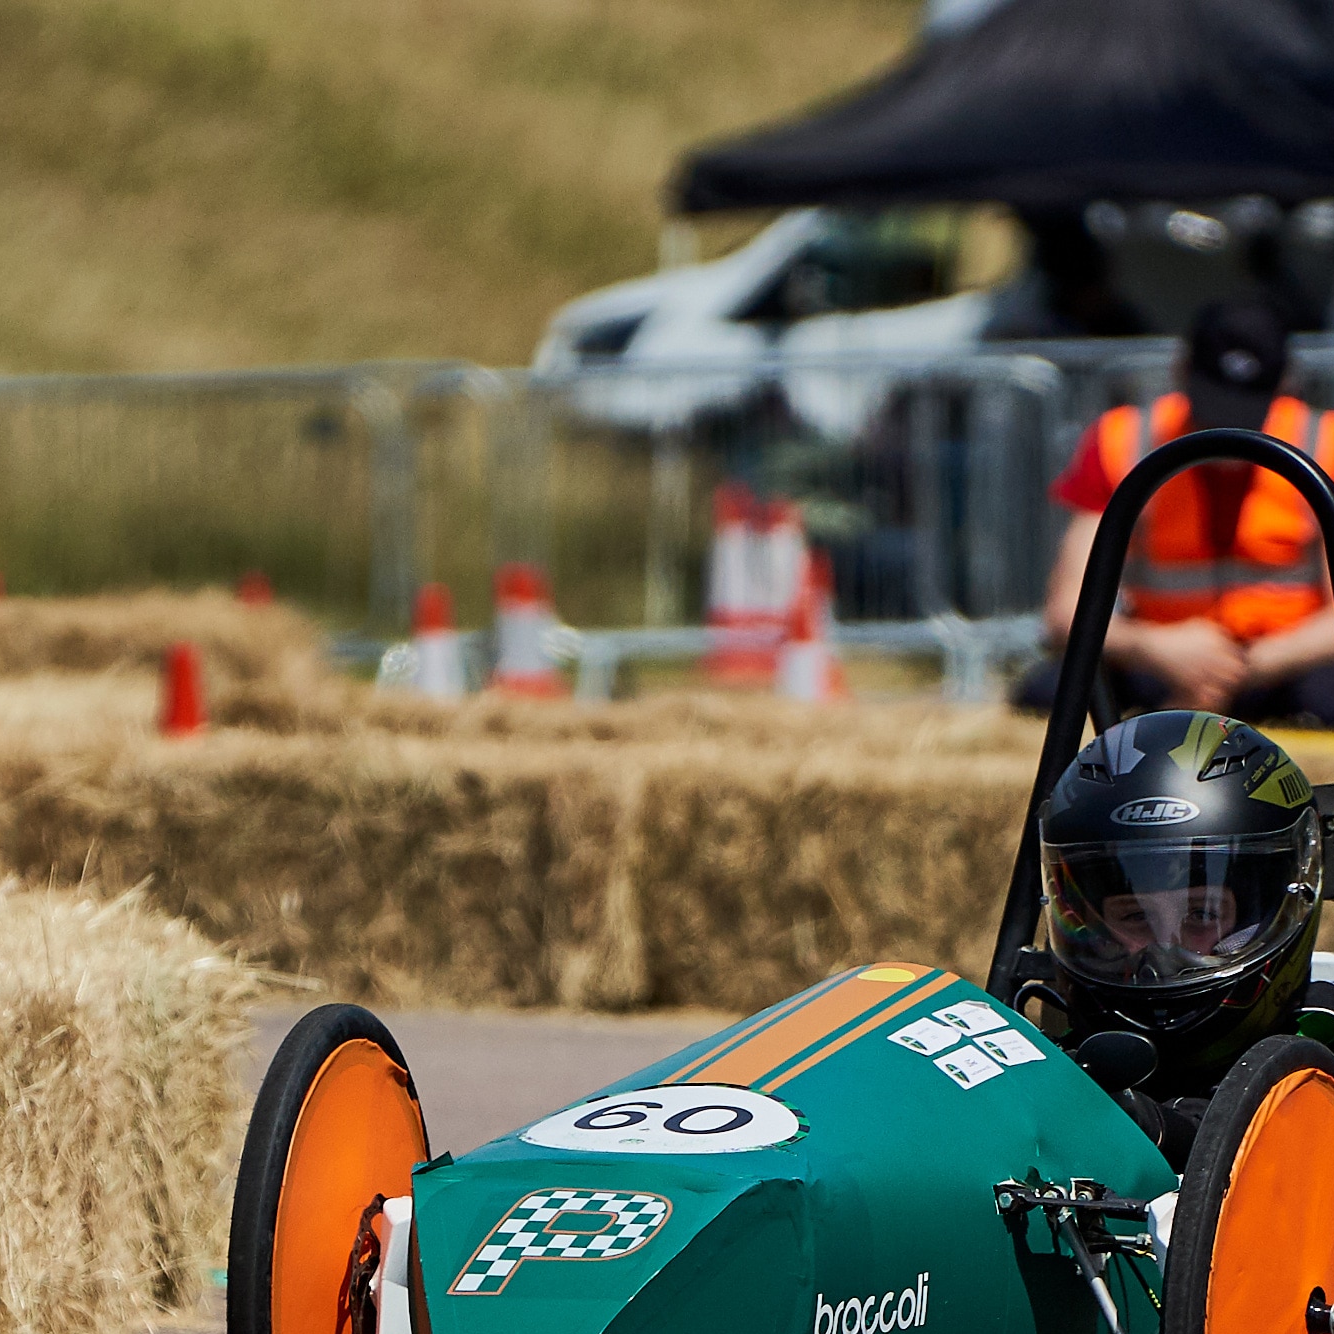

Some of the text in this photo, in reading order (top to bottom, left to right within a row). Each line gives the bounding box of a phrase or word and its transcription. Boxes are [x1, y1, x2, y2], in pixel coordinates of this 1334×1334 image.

[1121, 803, 1188, 820] HJC
[574, 1101, 754, 1135] 60
[446, 1187, 673, 1295] P
